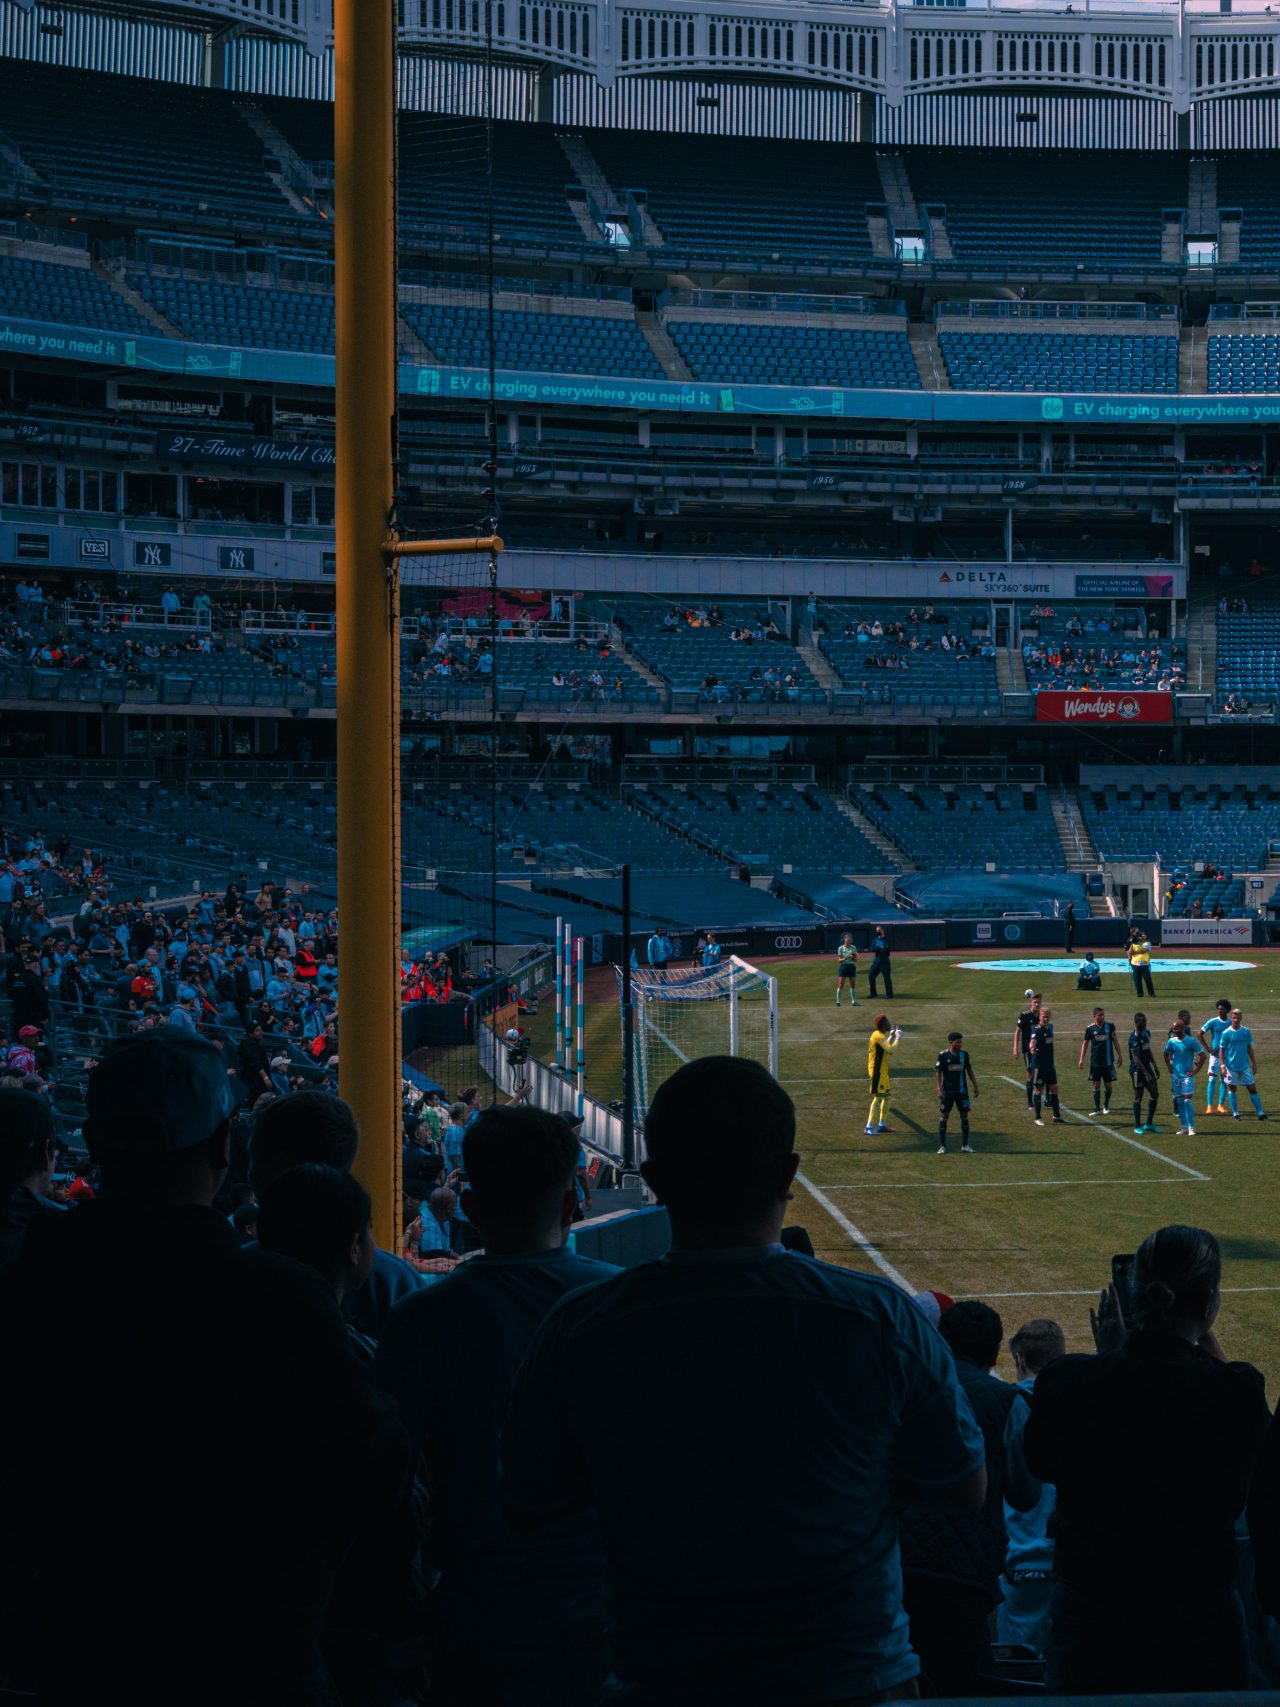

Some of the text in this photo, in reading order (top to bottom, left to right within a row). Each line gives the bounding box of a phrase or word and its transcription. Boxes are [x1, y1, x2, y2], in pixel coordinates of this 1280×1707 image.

[39, 336, 65, 350] you
[69, 339, 102, 354] need
[105, 341, 116, 356] it
[451, 376, 471, 390] EV
[475, 378, 537, 398] charging
[542, 383, 625, 400] everywhere
[630, 391, 655, 403] you
[660, 390, 695, 405] need
[700, 391, 710, 405] it
[1074, 402, 1094, 415] EV
[1099, 402, 1159, 419] charging
[1164, 403, 1249, 420] everywhere
[1253, 406, 1280, 420] you
[169, 436, 245, 458] 27-Time
[251, 441, 307, 463] World
[1004, 480, 1026, 489] 1958
[85, 542, 105, 553] YES
[956, 571, 1006, 582] DELTA
[1023, 584, 1050, 593] SUITE
[1064, 697, 1115, 718] Wendy's
